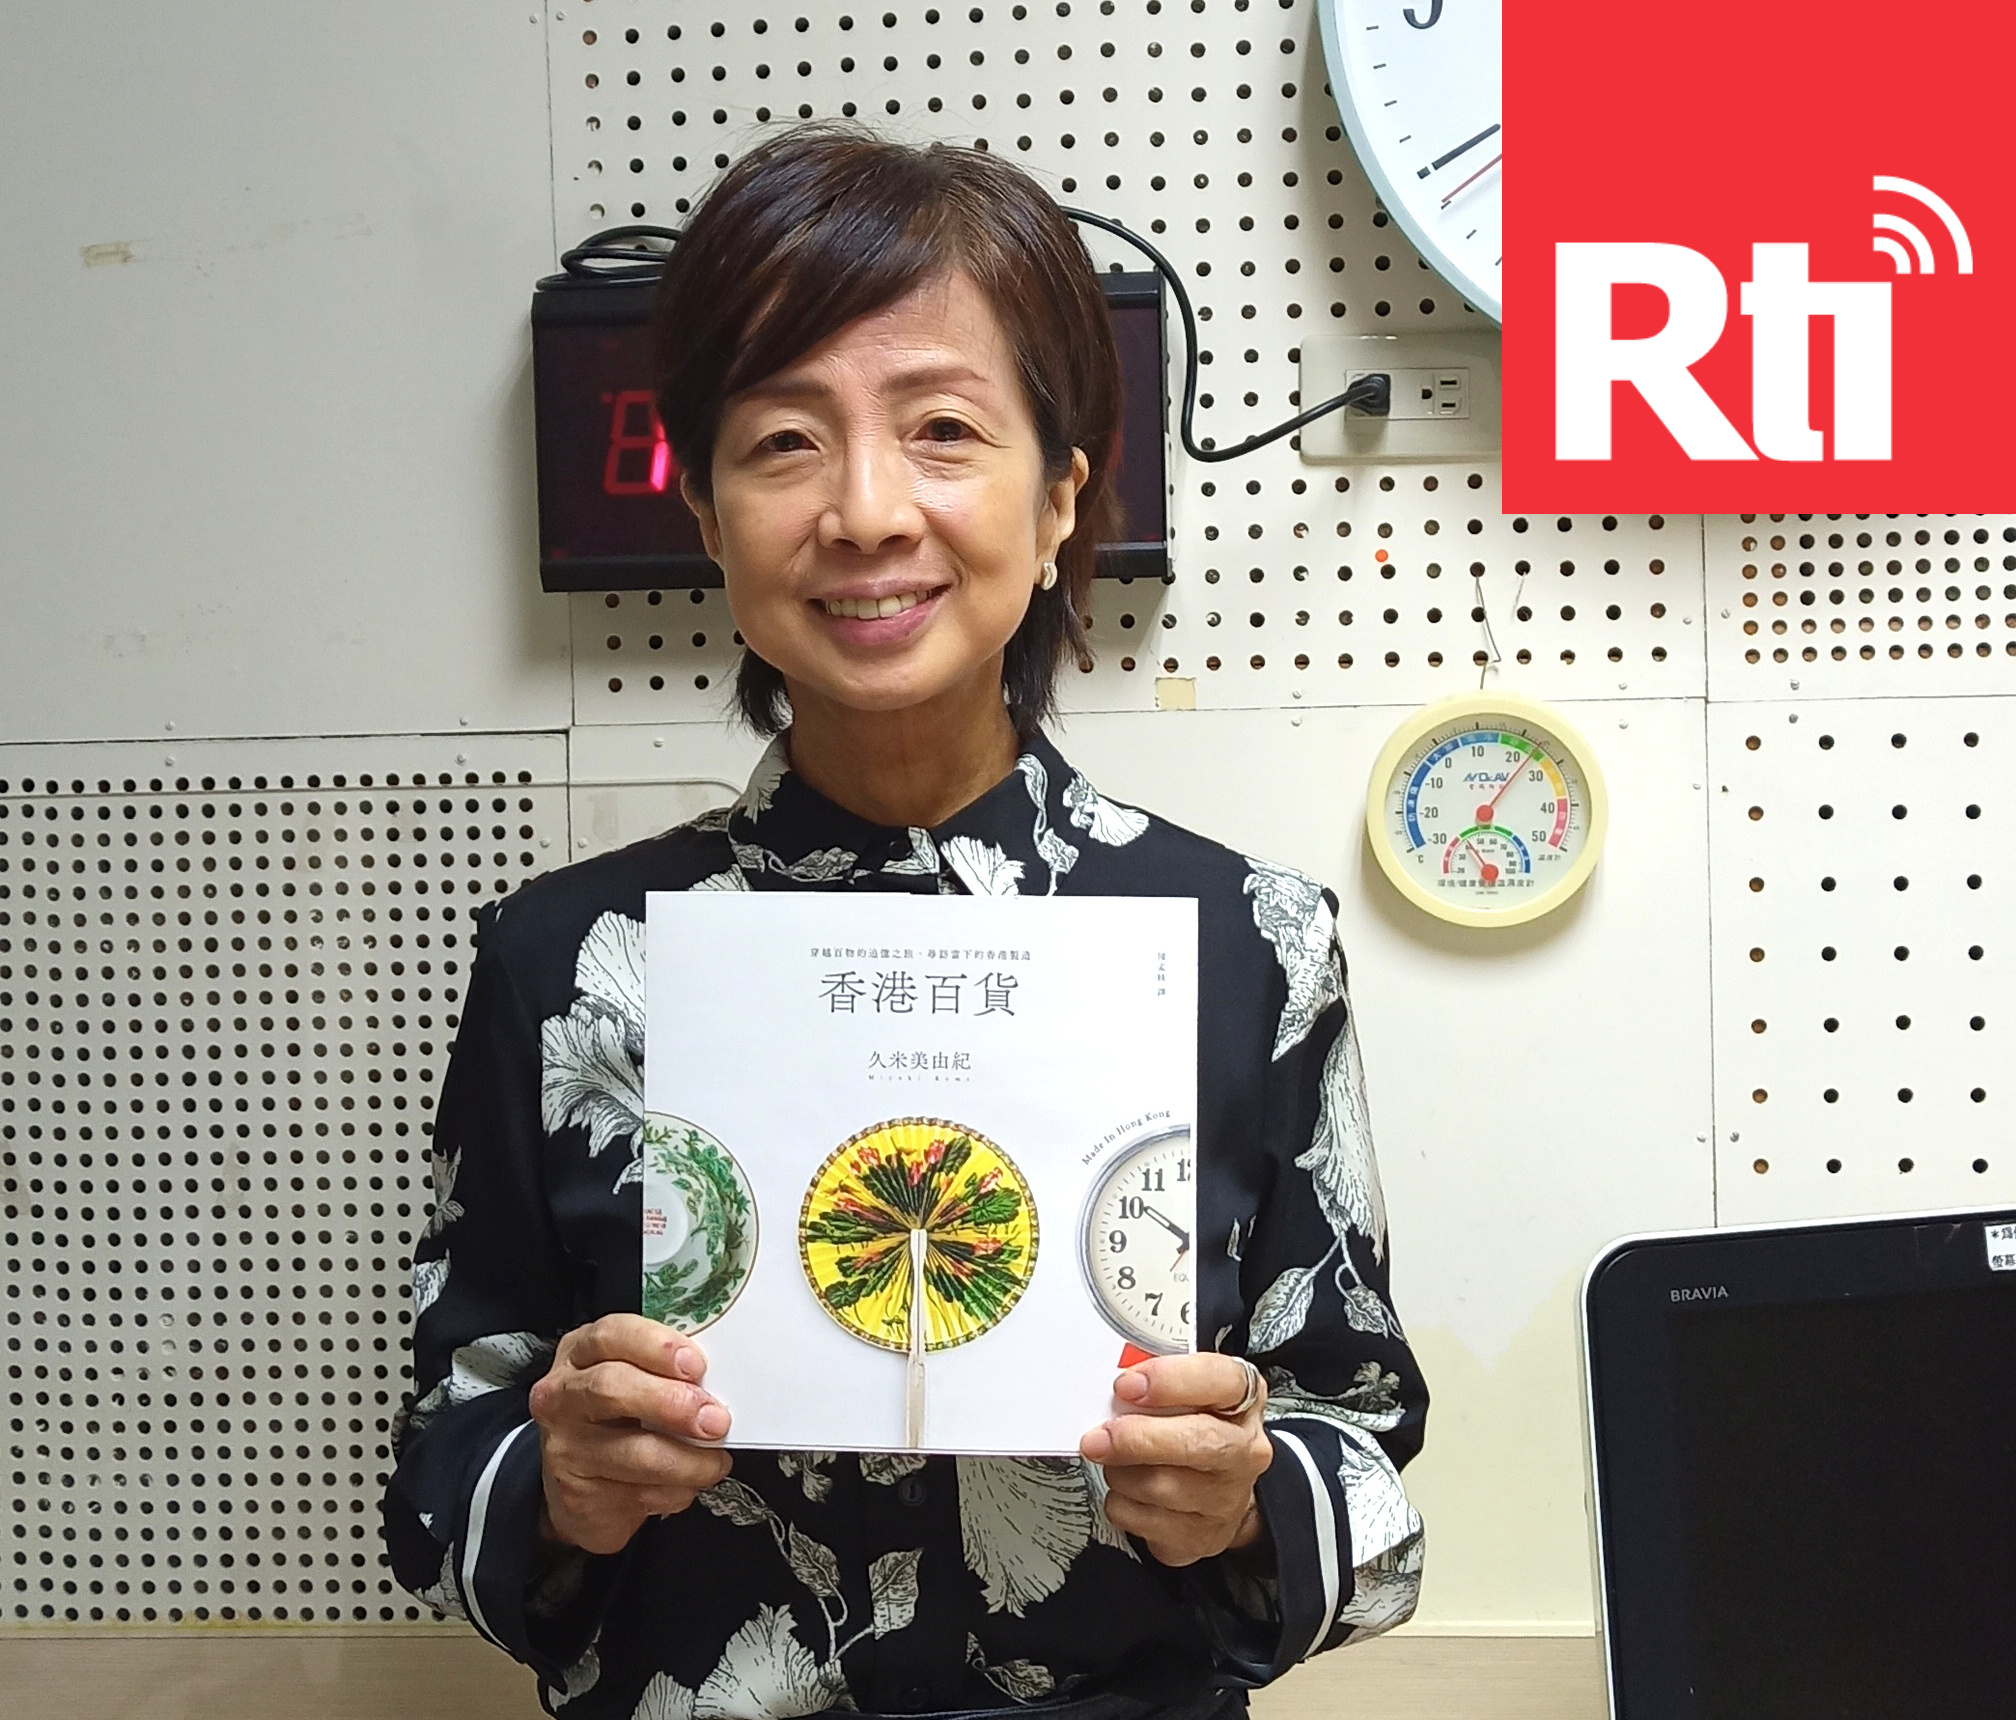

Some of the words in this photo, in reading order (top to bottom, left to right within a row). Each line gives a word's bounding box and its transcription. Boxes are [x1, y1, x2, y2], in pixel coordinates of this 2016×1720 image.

[1471, 746, 1485, 758] 10
[1505, 751, 1521, 763] 20
[1444, 757, 1453, 770] 0
[1425, 777, 1444, 789] -10
[1528, 770, 1544, 782] 30
[1419, 807, 1439, 819] -20
[1540, 802, 1555, 814] 40
[1427, 833, 1447, 845] -30
[1531, 831, 1547, 843] 50
[818, 969, 1020, 1018] 香港百貨
[867, 1050, 972, 1072] 久米美由紀
[1081, 1142, 1104, 1166] Made
[1104, 1133, 1116, 1144] In
[1115, 1119, 1143, 1136] Hong
[1144, 1110, 1171, 1122] Kong
[1141, 1167, 1165, 1192] 11
[1118, 1196, 1145, 1219] 10
[1108, 1229, 1127, 1253] 9
[1117, 1266, 1136, 1290] 8
[1670, 1285, 1730, 1303] BRAVIA
[1144, 1292, 1164, 1316] 7
